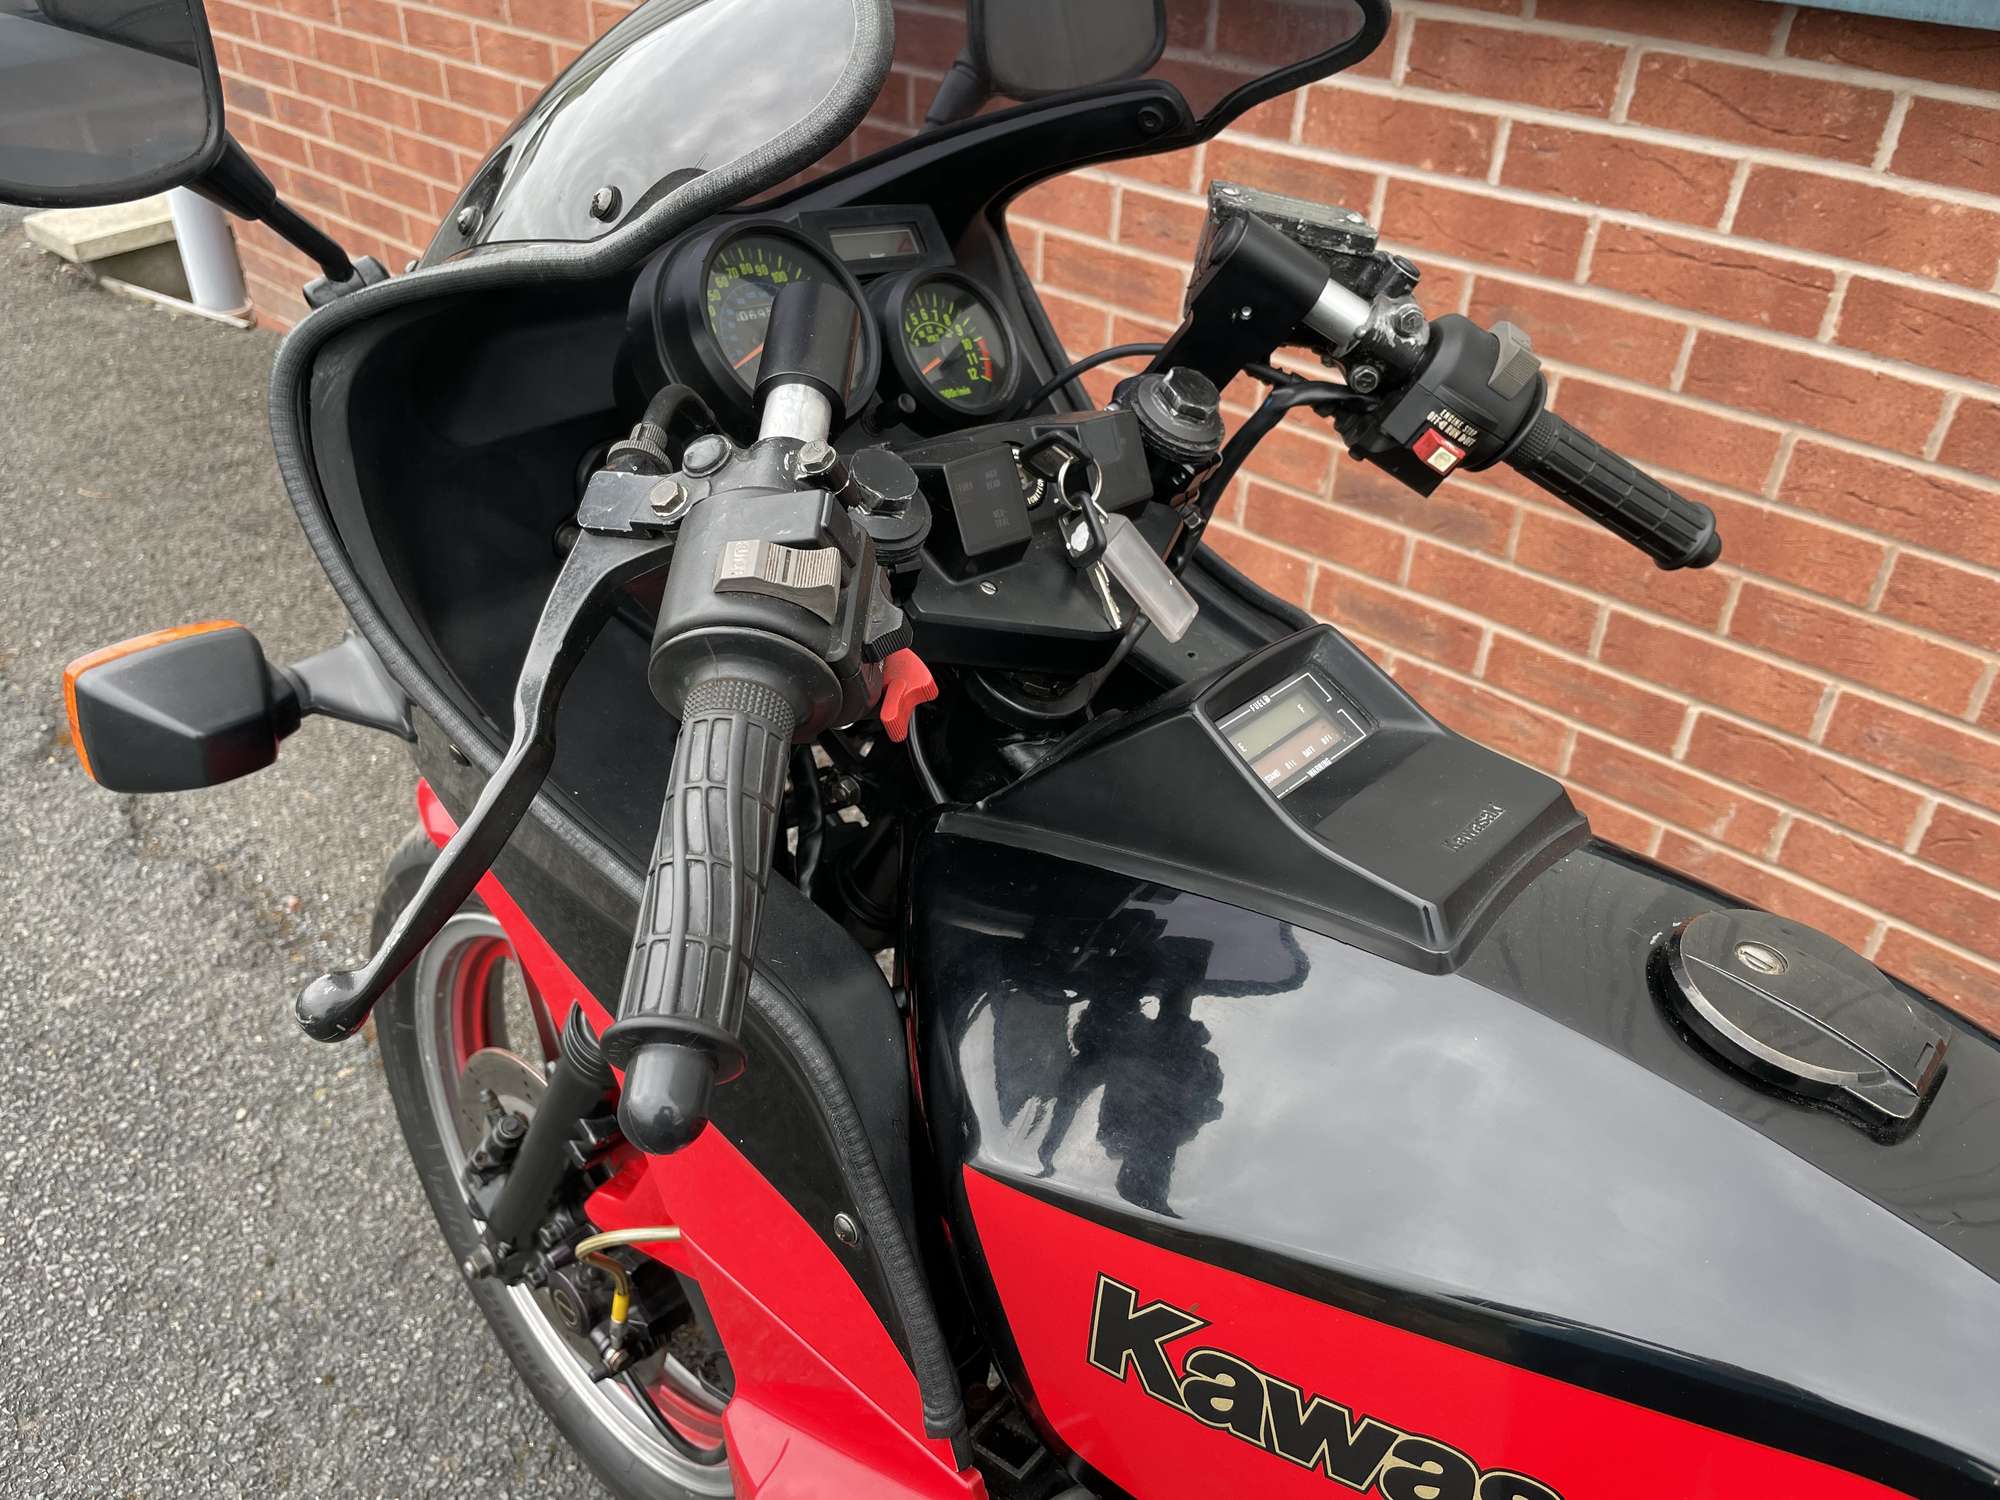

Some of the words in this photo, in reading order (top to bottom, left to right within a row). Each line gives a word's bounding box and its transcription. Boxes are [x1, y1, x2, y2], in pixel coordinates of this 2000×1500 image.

[726, 266, 740, 280] 70
[740, 262, 754, 275] 80
[755, 263, 769, 276] 90
[771, 270, 788, 284] 100
[910, 313, 919, 325] 5
[920, 308, 928, 321] 6
[931, 309, 939, 322] 7
[943, 313, 952, 326] 8
[955, 323, 963, 337] 9
[962, 338, 973, 351] 10
[967, 352, 978, 366] 11
[967, 367, 979, 380] 12
[1426, 410, 1440, 425] OFF
[1444, 424, 1461, 439] RUN
[1440, 409, 1464, 429] ENGINE
[1462, 424, 1478, 437] STOP
[1249, 696, 1268, 712] FUEL
[1297, 703, 1305, 713] F
[1237, 742, 1247, 753] E
[1307, 758, 1332, 777] WARNING
